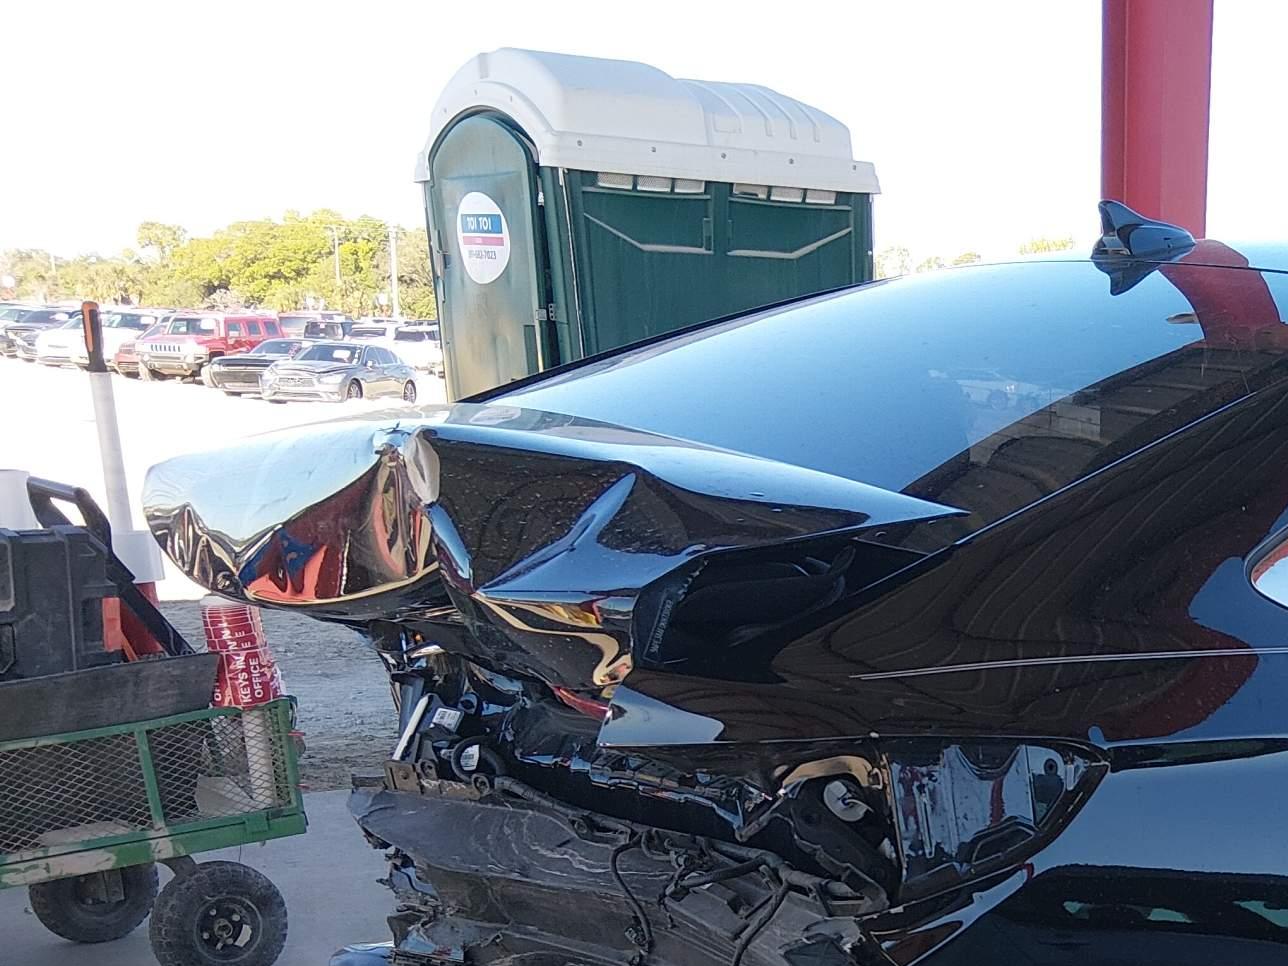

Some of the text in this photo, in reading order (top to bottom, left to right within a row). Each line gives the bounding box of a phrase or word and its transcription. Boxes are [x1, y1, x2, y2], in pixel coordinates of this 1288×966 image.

[235, 656, 252, 703] KEYS IN
[250, 658, 264, 698] OFFICE
